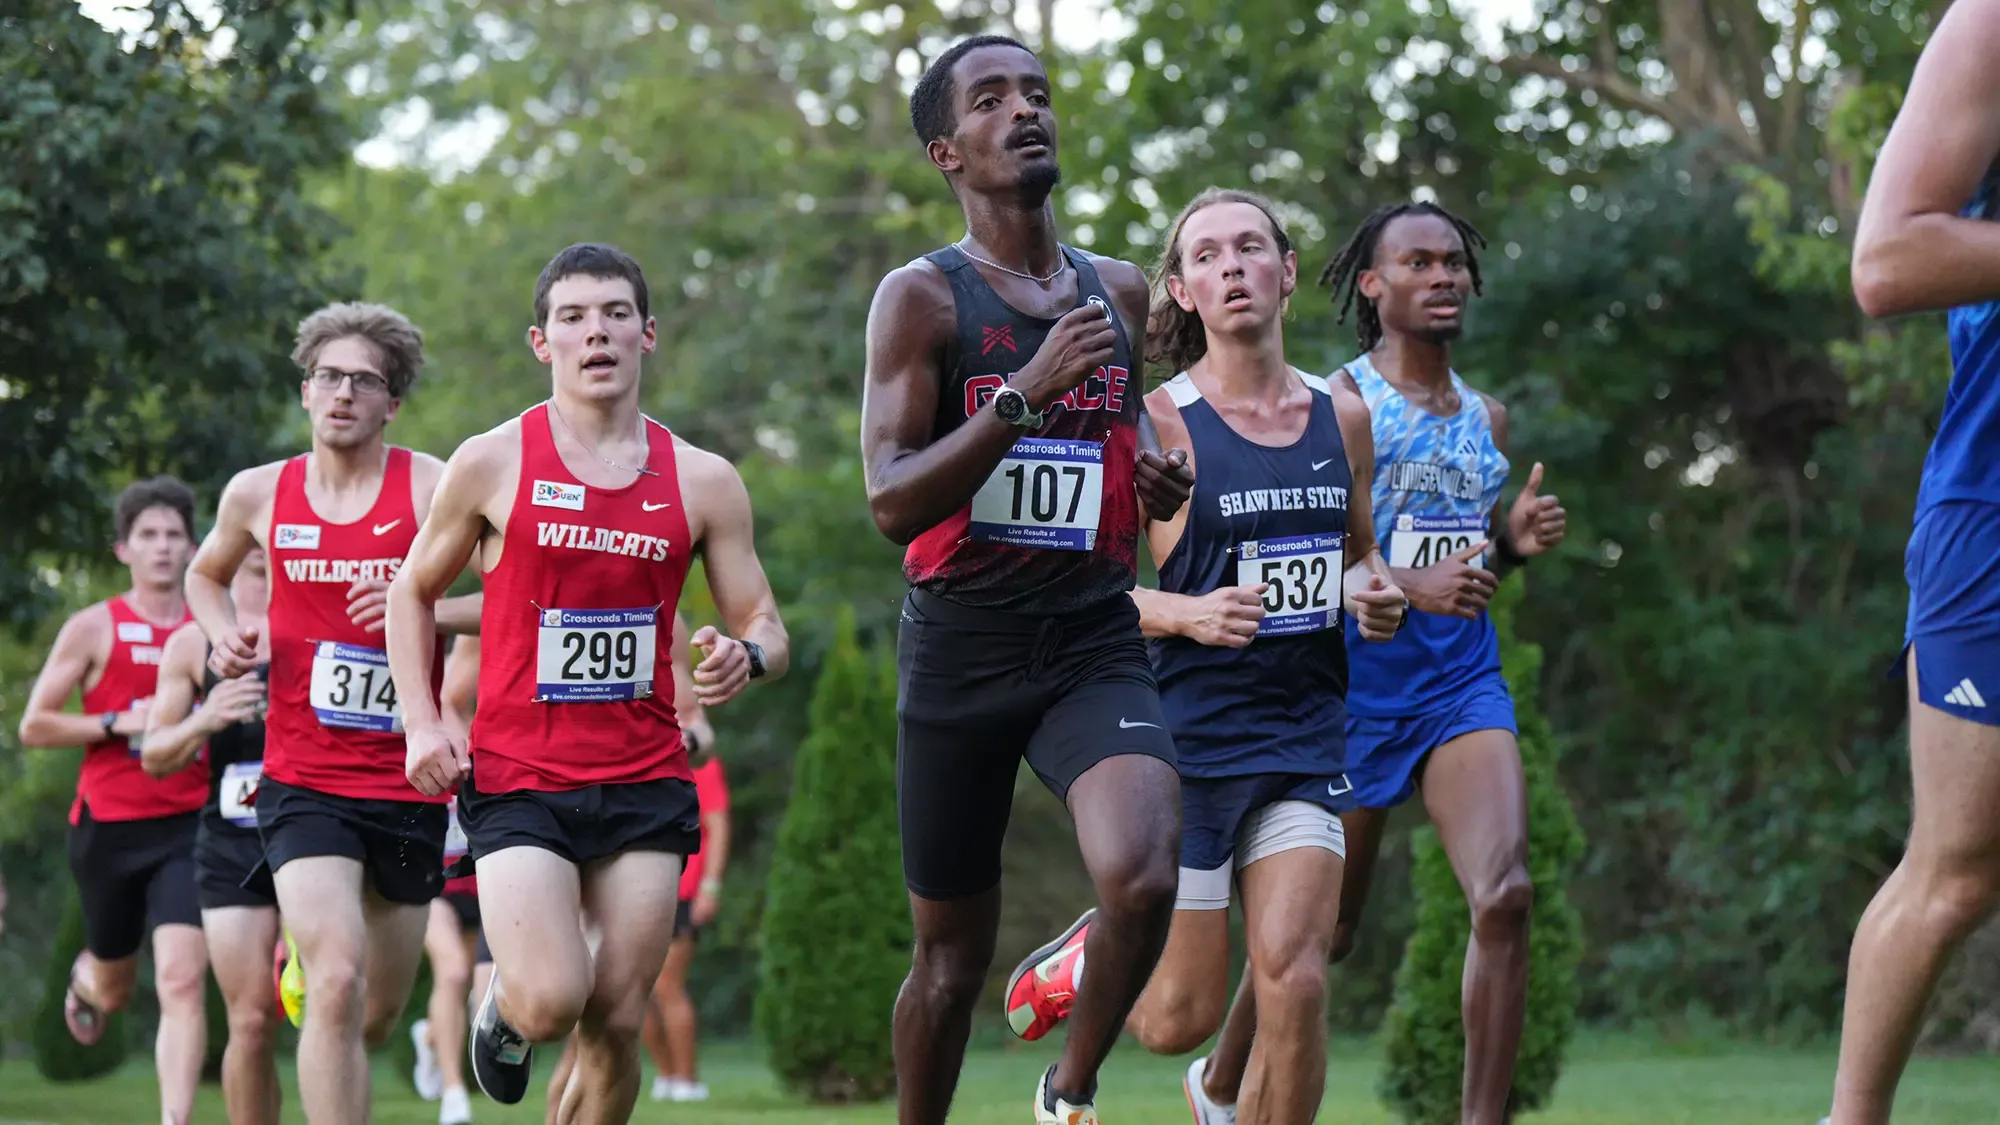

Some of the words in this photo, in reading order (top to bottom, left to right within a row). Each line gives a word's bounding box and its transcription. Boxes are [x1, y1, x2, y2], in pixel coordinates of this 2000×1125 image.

[965, 365, 1129, 419] GCE
[1009, 443, 1066, 455] rossroads
[1069, 444, 1101, 459] Timing
[1005, 463, 1086, 523] 107
[1219, 487, 1305, 517] SHAWNEE
[1306, 486, 1347, 511] STATE
[537, 522, 670, 562] WILDCATS
[988, 534, 1074, 548] live.crossroadstiming.com
[1023, 528, 1047, 537] Results
[1259, 540, 1312, 553] Crossroads
[1314, 537, 1341, 547] Timing
[283, 557, 402, 583] WILDCATS
[1261, 556, 1327, 613] 532
[563, 613, 620, 623] Crossroads
[623, 612, 654, 622] Timing
[561, 630, 637, 680] 299
[329, 664, 397, 713] 314
